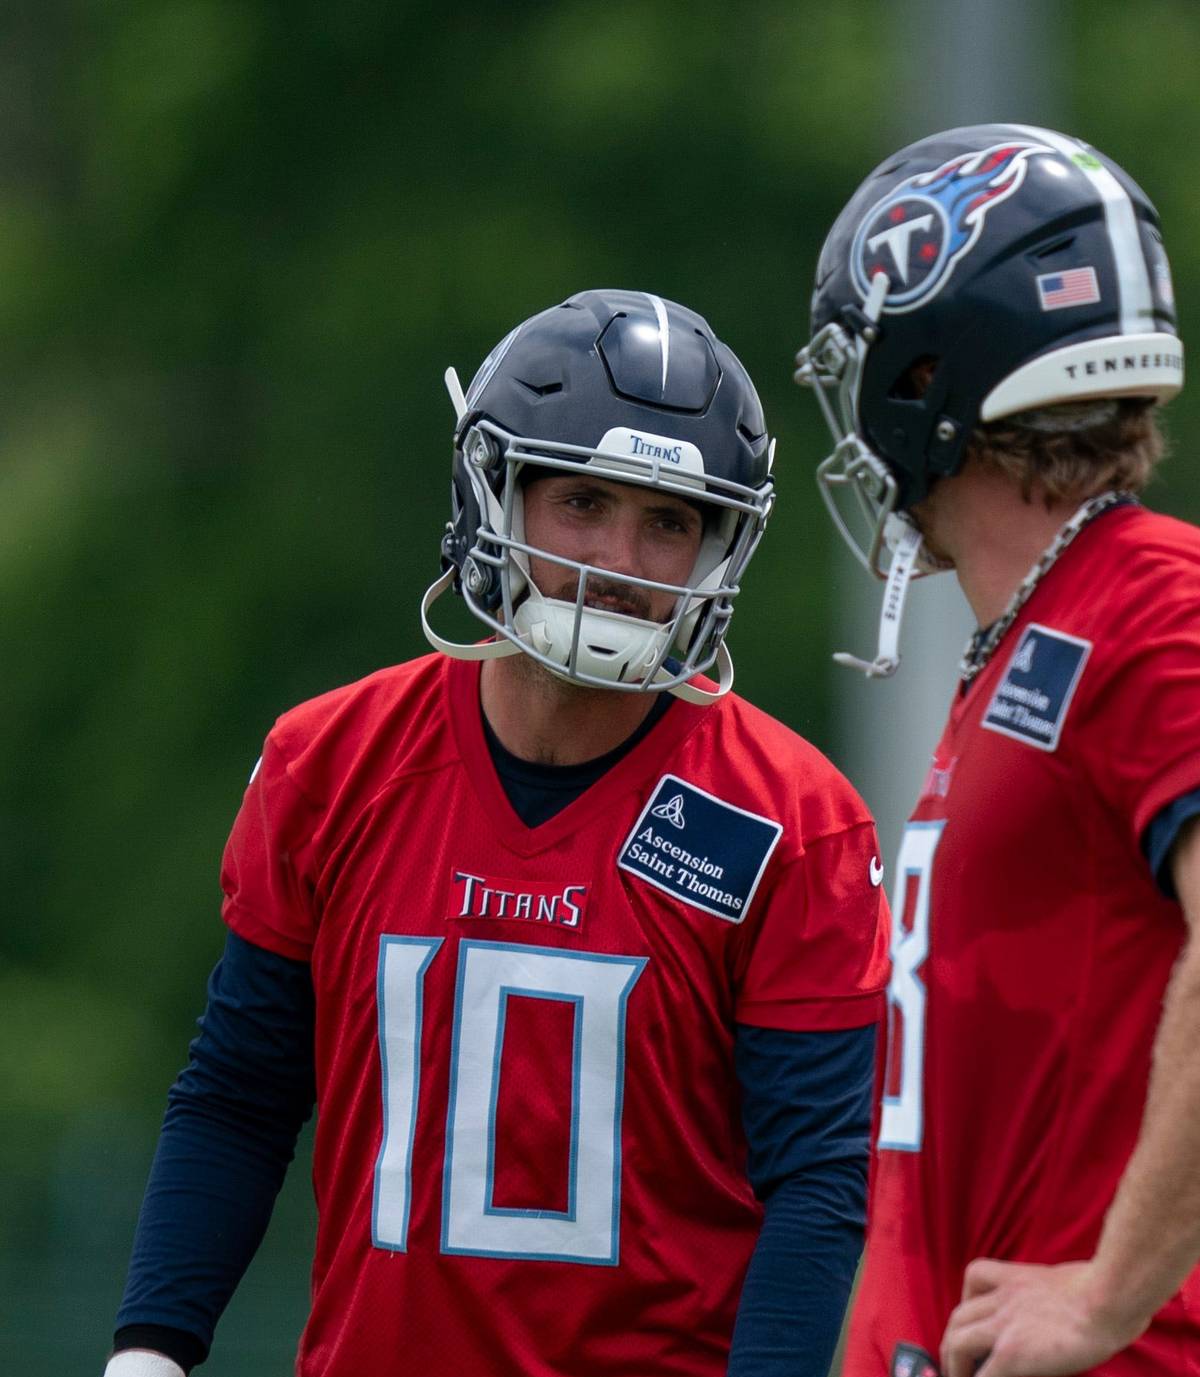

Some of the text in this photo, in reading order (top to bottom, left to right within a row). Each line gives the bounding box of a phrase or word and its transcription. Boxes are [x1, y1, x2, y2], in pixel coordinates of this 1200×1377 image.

[628, 843, 743, 909] Saint Thomas
[637, 827, 724, 880] Ascension
[453, 871, 587, 927] TITANS
[372, 933, 650, 1267] 10
